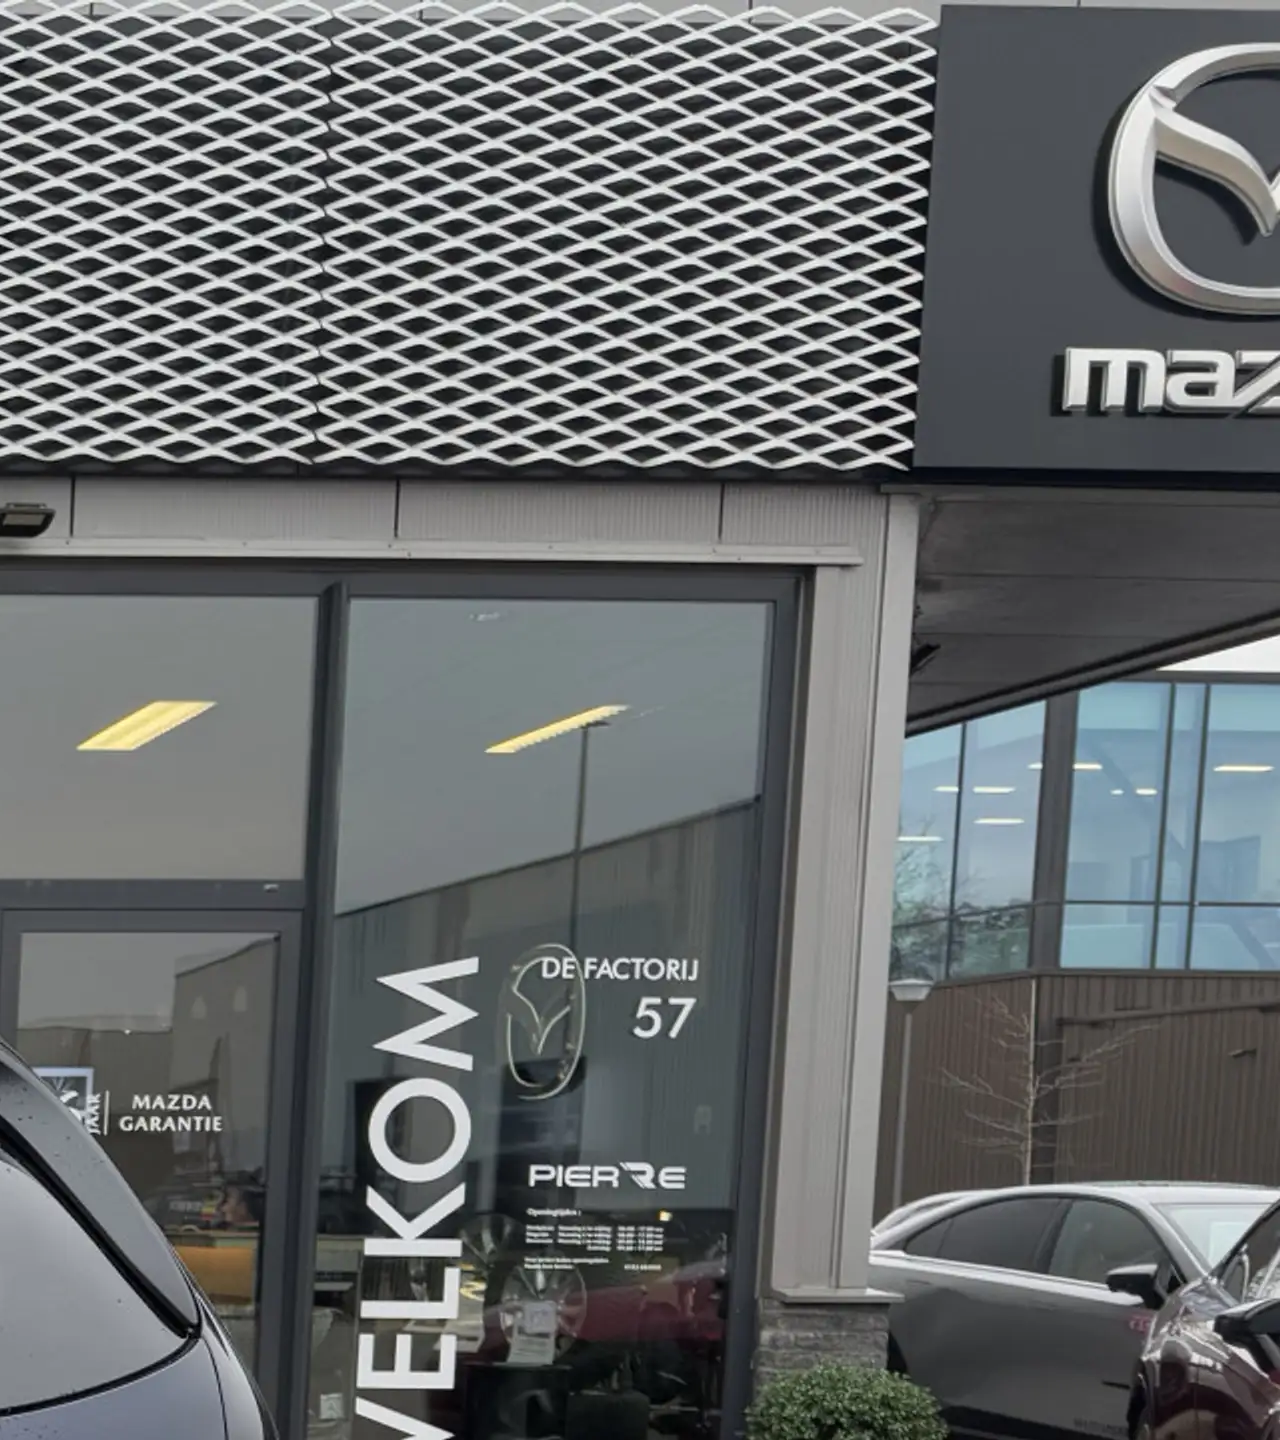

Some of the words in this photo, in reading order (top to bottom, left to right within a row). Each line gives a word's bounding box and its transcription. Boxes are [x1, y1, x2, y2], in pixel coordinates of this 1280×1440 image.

[542, 957, 576, 979] DE
[584, 957, 699, 981] FACTORIJ
[633, 997, 697, 1039] 57
[131, 1094, 212, 1110] MAZDA
[119, 1116, 223, 1132] GARANTIE
[528, 1162, 687, 1189] PIERRE
